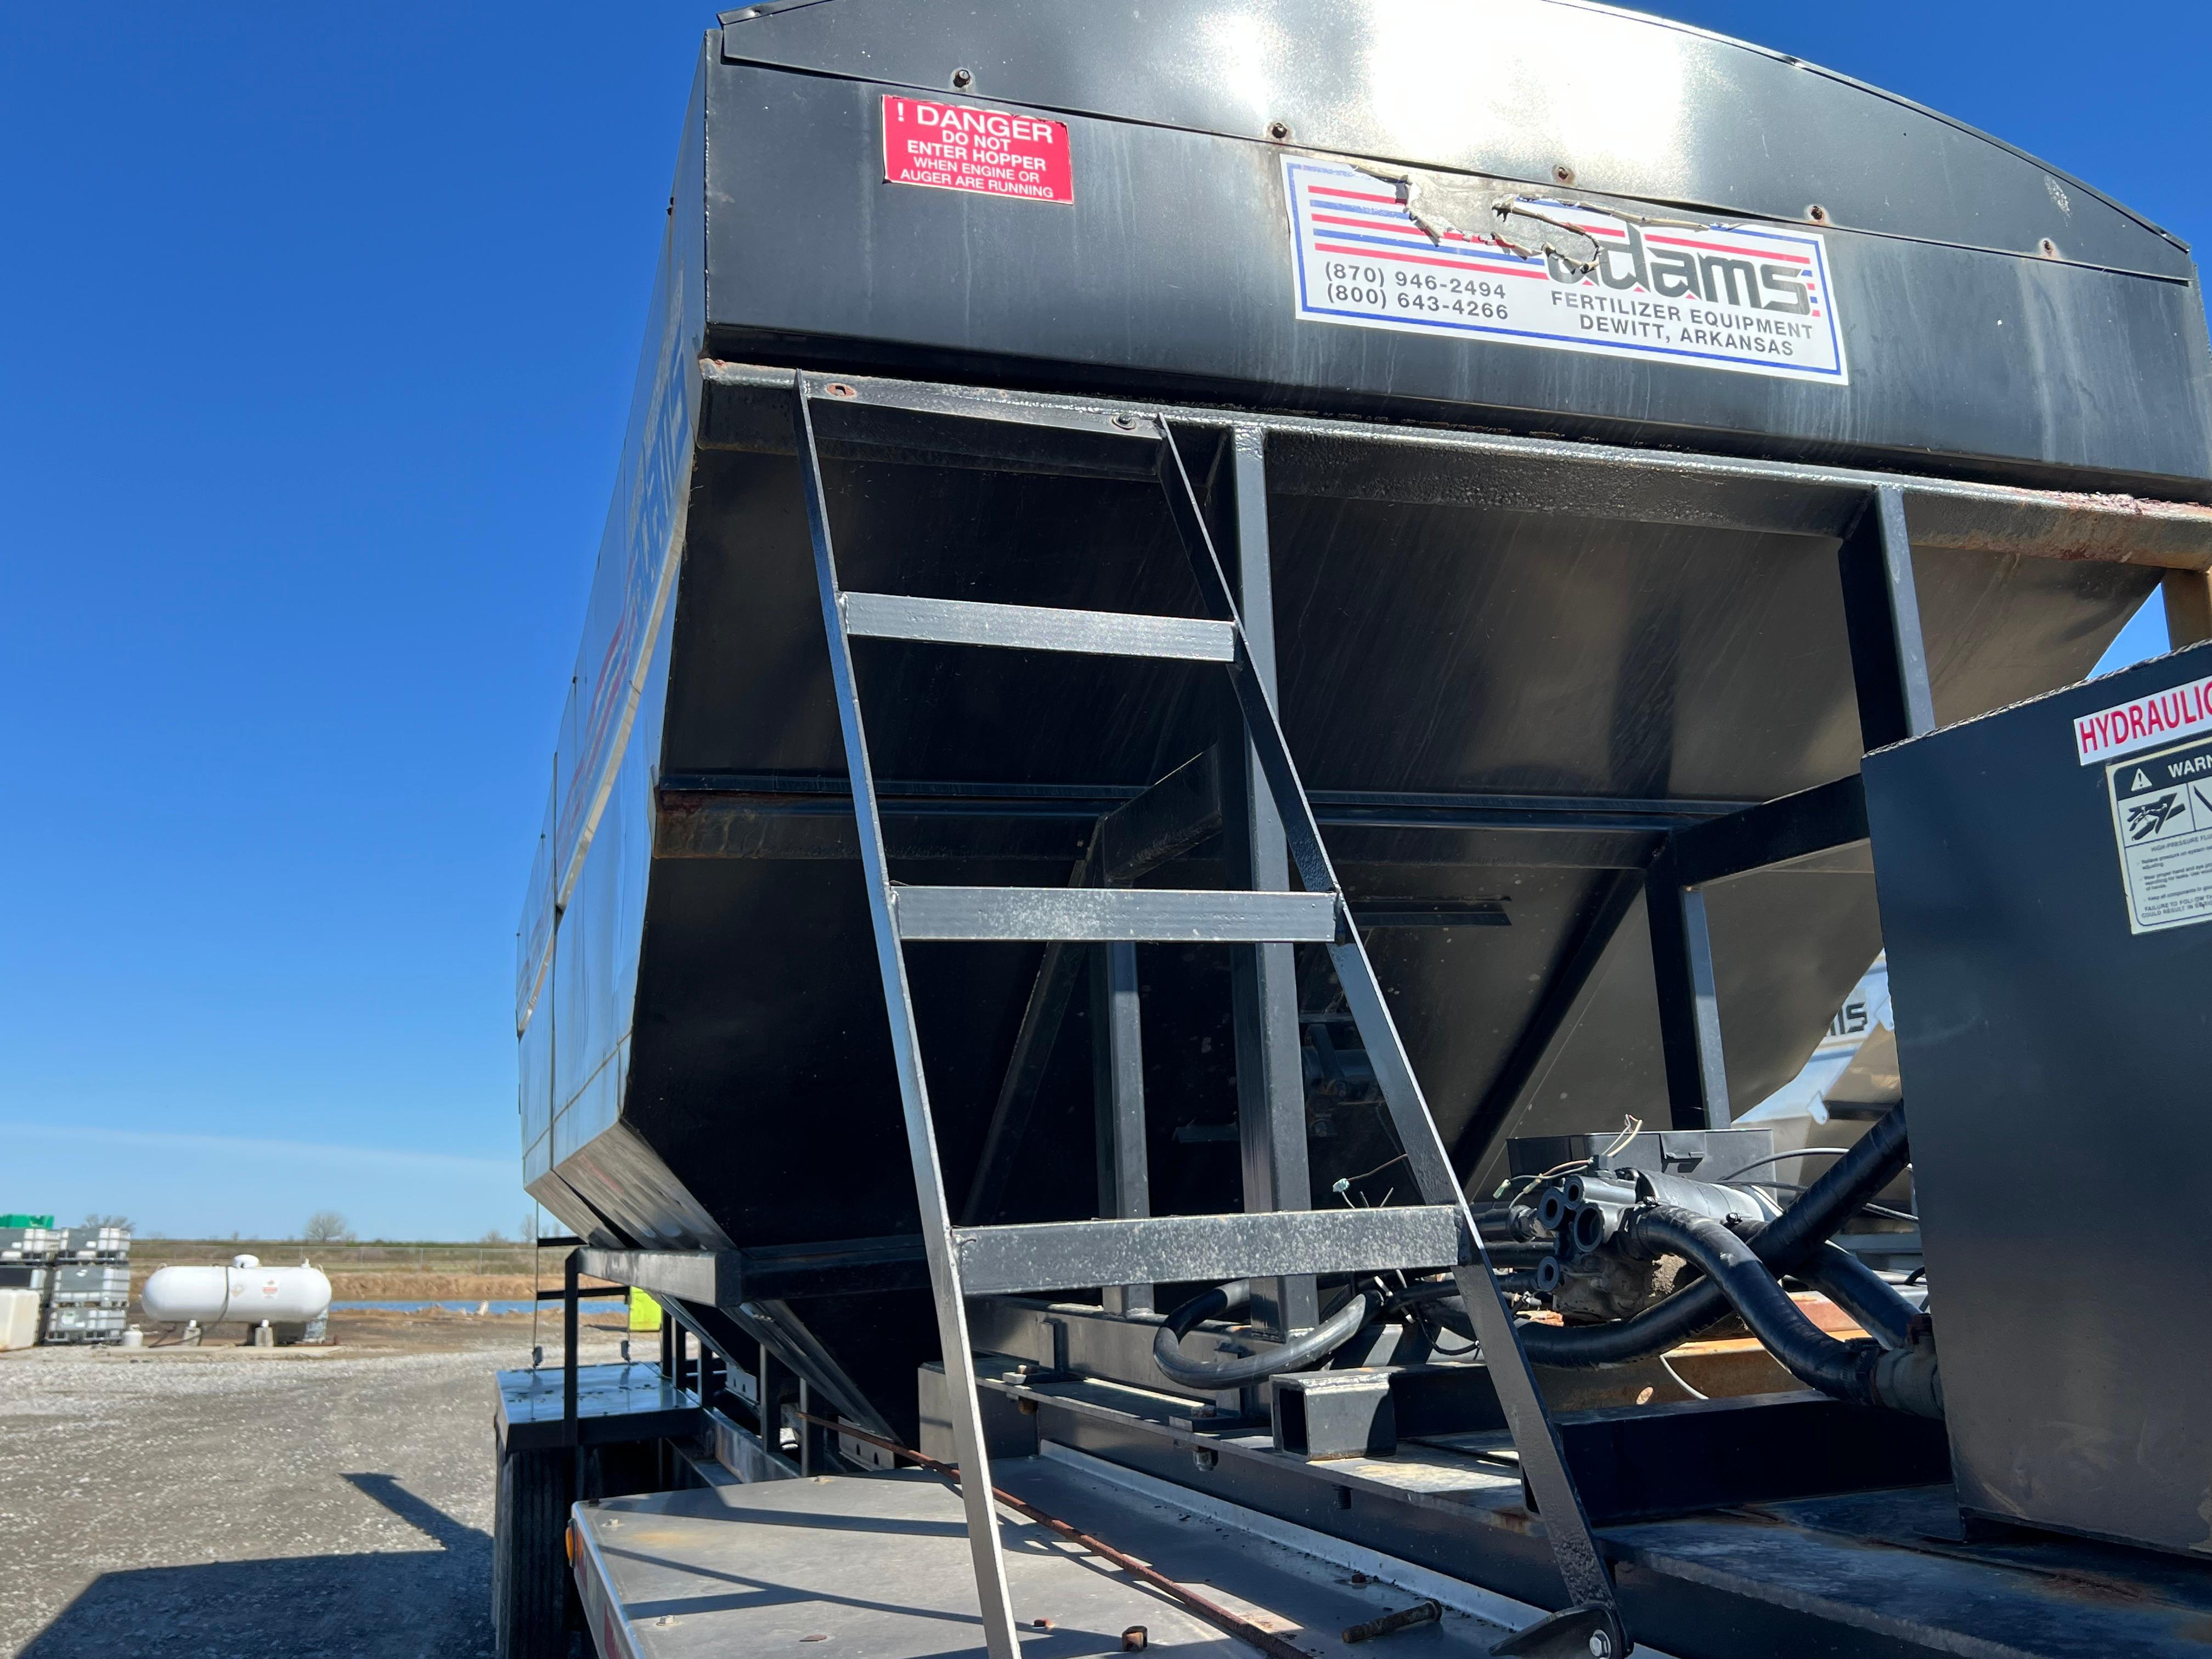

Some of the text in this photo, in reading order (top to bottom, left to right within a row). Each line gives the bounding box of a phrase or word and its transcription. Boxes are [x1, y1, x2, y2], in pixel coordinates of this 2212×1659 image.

[917, 105, 1053, 144] DANGER
[943, 130, 1011, 151] DO NOT
[907, 140, 1047, 171] ENTER HOPPER
[913, 156, 1040, 183] WHEN ENGINE OR
[900, 169, 1054, 199] AUGER ARE RUNNING
[1325, 261, 1506, 300] (870) 946-2494
[1327, 283, 1508, 320] (800) 643-4266
[1551, 290, 1813, 340] FERTILIZER EQUIPMENT
[1579, 314, 1793, 356] DEWITT, ARKANSAS
